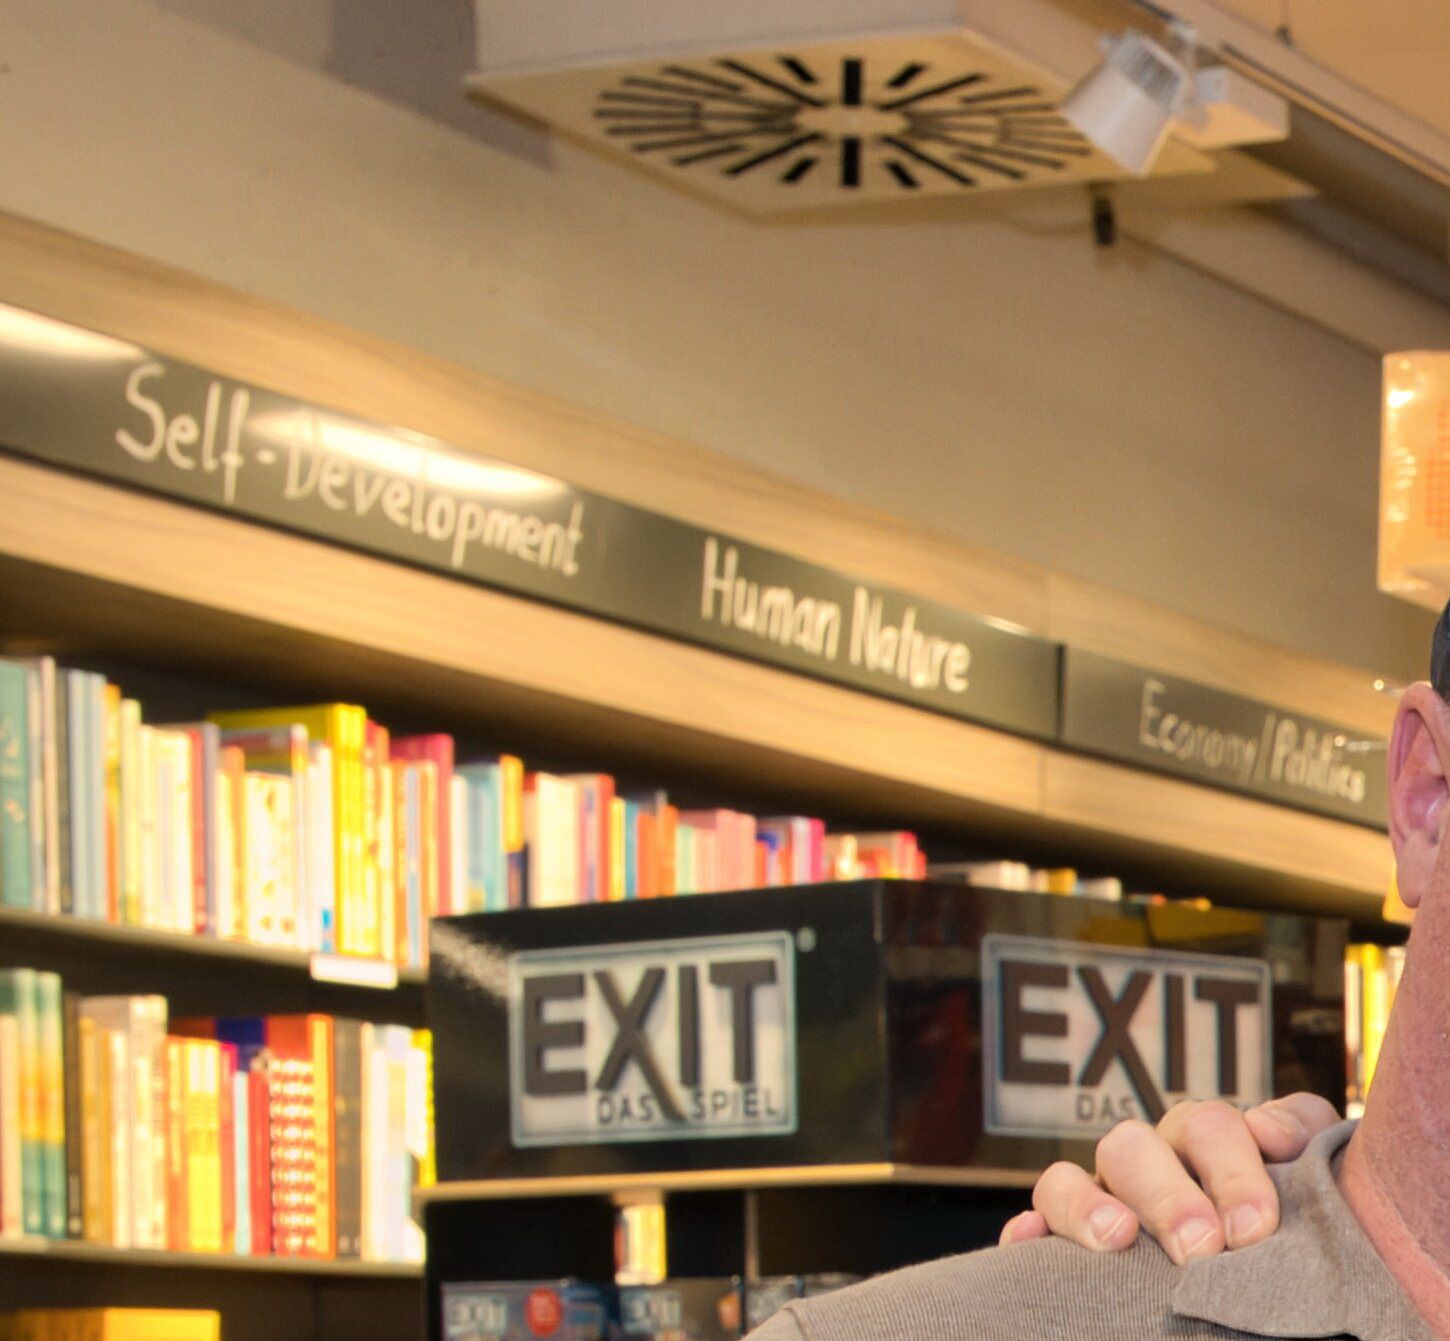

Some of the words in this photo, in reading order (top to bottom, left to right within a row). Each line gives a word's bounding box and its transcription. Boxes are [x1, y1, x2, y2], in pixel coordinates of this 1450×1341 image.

[701, 535, 841, 662] Human
[850, 584, 971, 693] Nature
[523, 960, 777, 1122] EXIT
[597, 1092, 651, 1125] DAS
[689, 1084, 779, 1121] SPIEL
[1001, 960, 1262, 1125] EXIT
